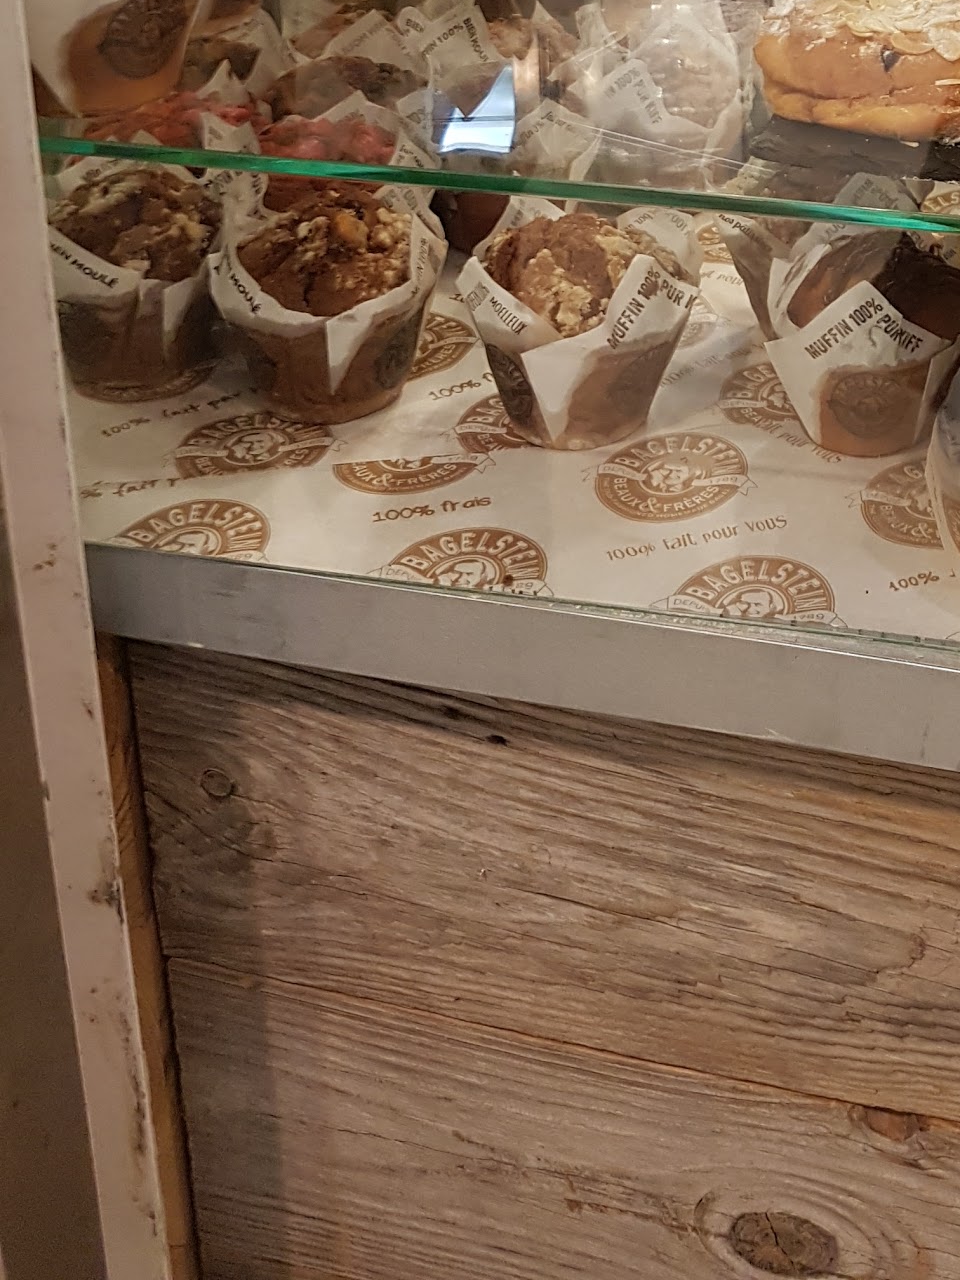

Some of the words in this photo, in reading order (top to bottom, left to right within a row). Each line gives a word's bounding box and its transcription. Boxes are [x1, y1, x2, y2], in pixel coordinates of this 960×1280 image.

[659, 278, 682, 307] PUR
[490, 296, 528, 336] MOELLEUX
[607, 301, 646, 350] MUFFIN
[804, 320, 853, 359] MUFFIN
[849, 297, 884, 327] 100%
[428, 380, 482, 401] 100%
[101, 417, 151, 438] 100%
[615, 435, 743, 475] BAGELSTEIN
[397, 462, 457, 487] FRÈRES
[372, 504, 435, 523] 100%
[441, 495, 492, 513] frais
[613, 477, 643, 510] BEAUX
[663, 485, 719, 513] FRÈRES
[128, 503, 263, 551] BAGELSTEIN
[606, 543, 655, 562] 100%
[662, 533, 697, 550] fait
[702, 524, 739, 543] pour
[401, 531, 541, 581] BAGELSTEIN
[685, 560, 827, 610] BAGELSTEIN
[889, 571, 940, 592] 100%
